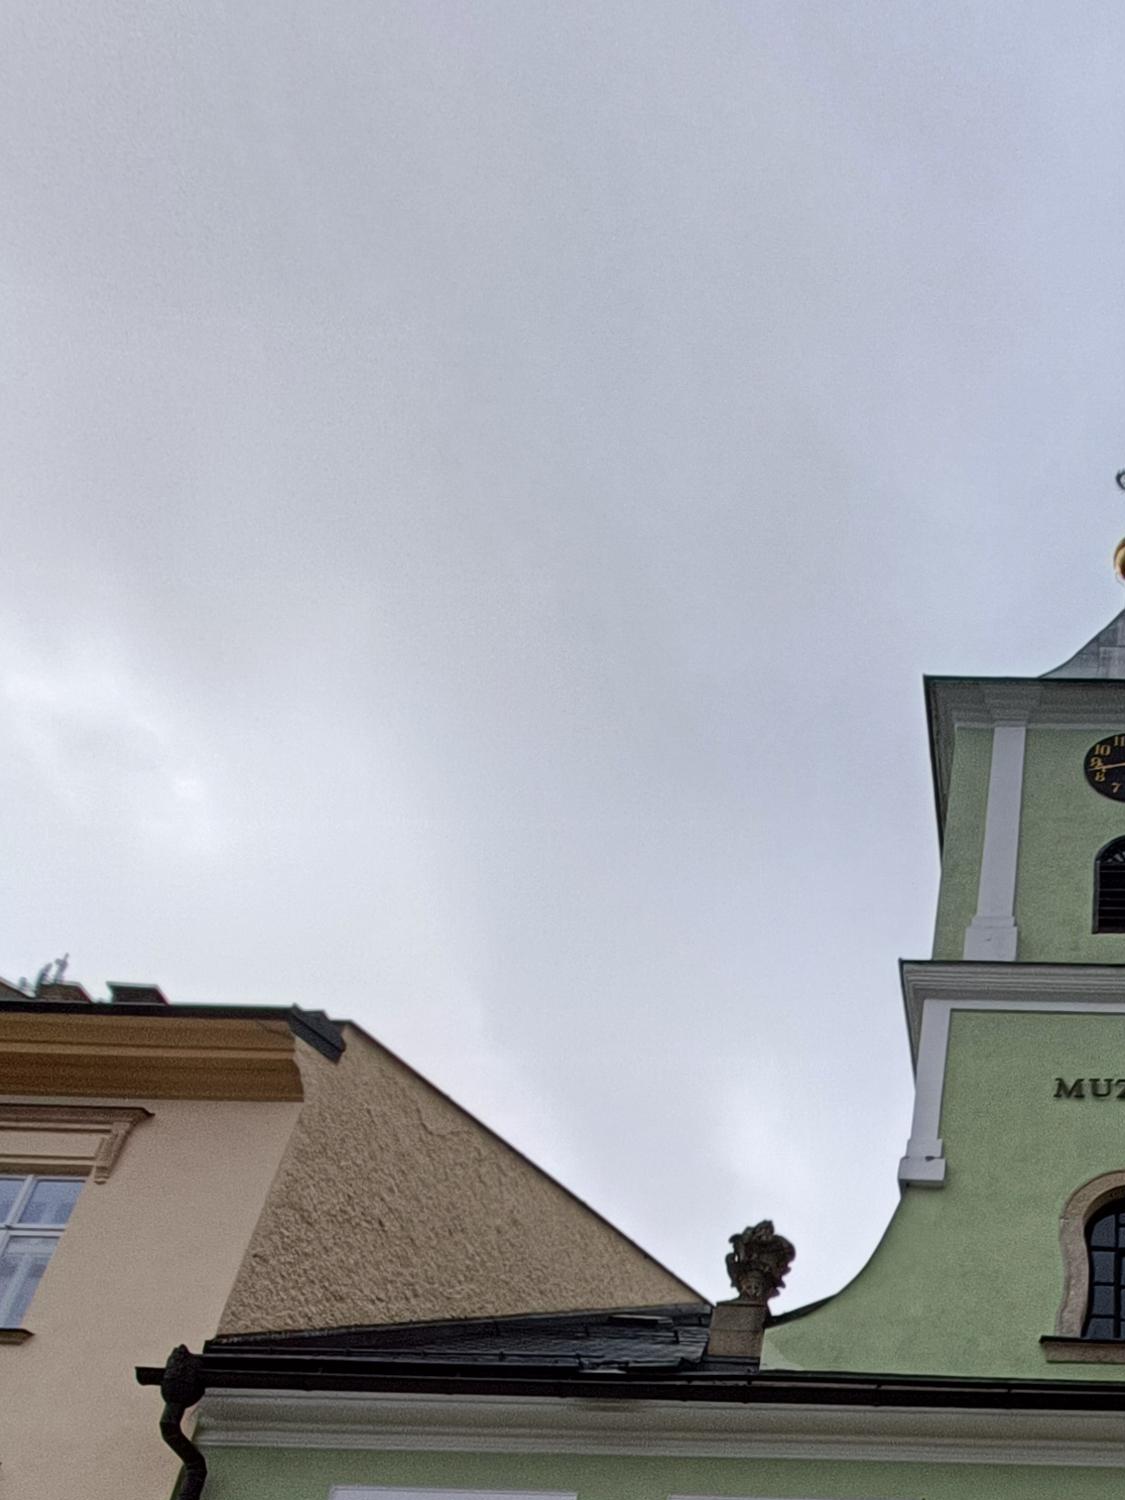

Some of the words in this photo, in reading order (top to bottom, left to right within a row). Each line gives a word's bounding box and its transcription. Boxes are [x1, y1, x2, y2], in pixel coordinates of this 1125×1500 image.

[1113, 735, 1125, 747] 11
[1094, 744, 1111, 756] 10
[1110, 782, 1121, 793] 7
